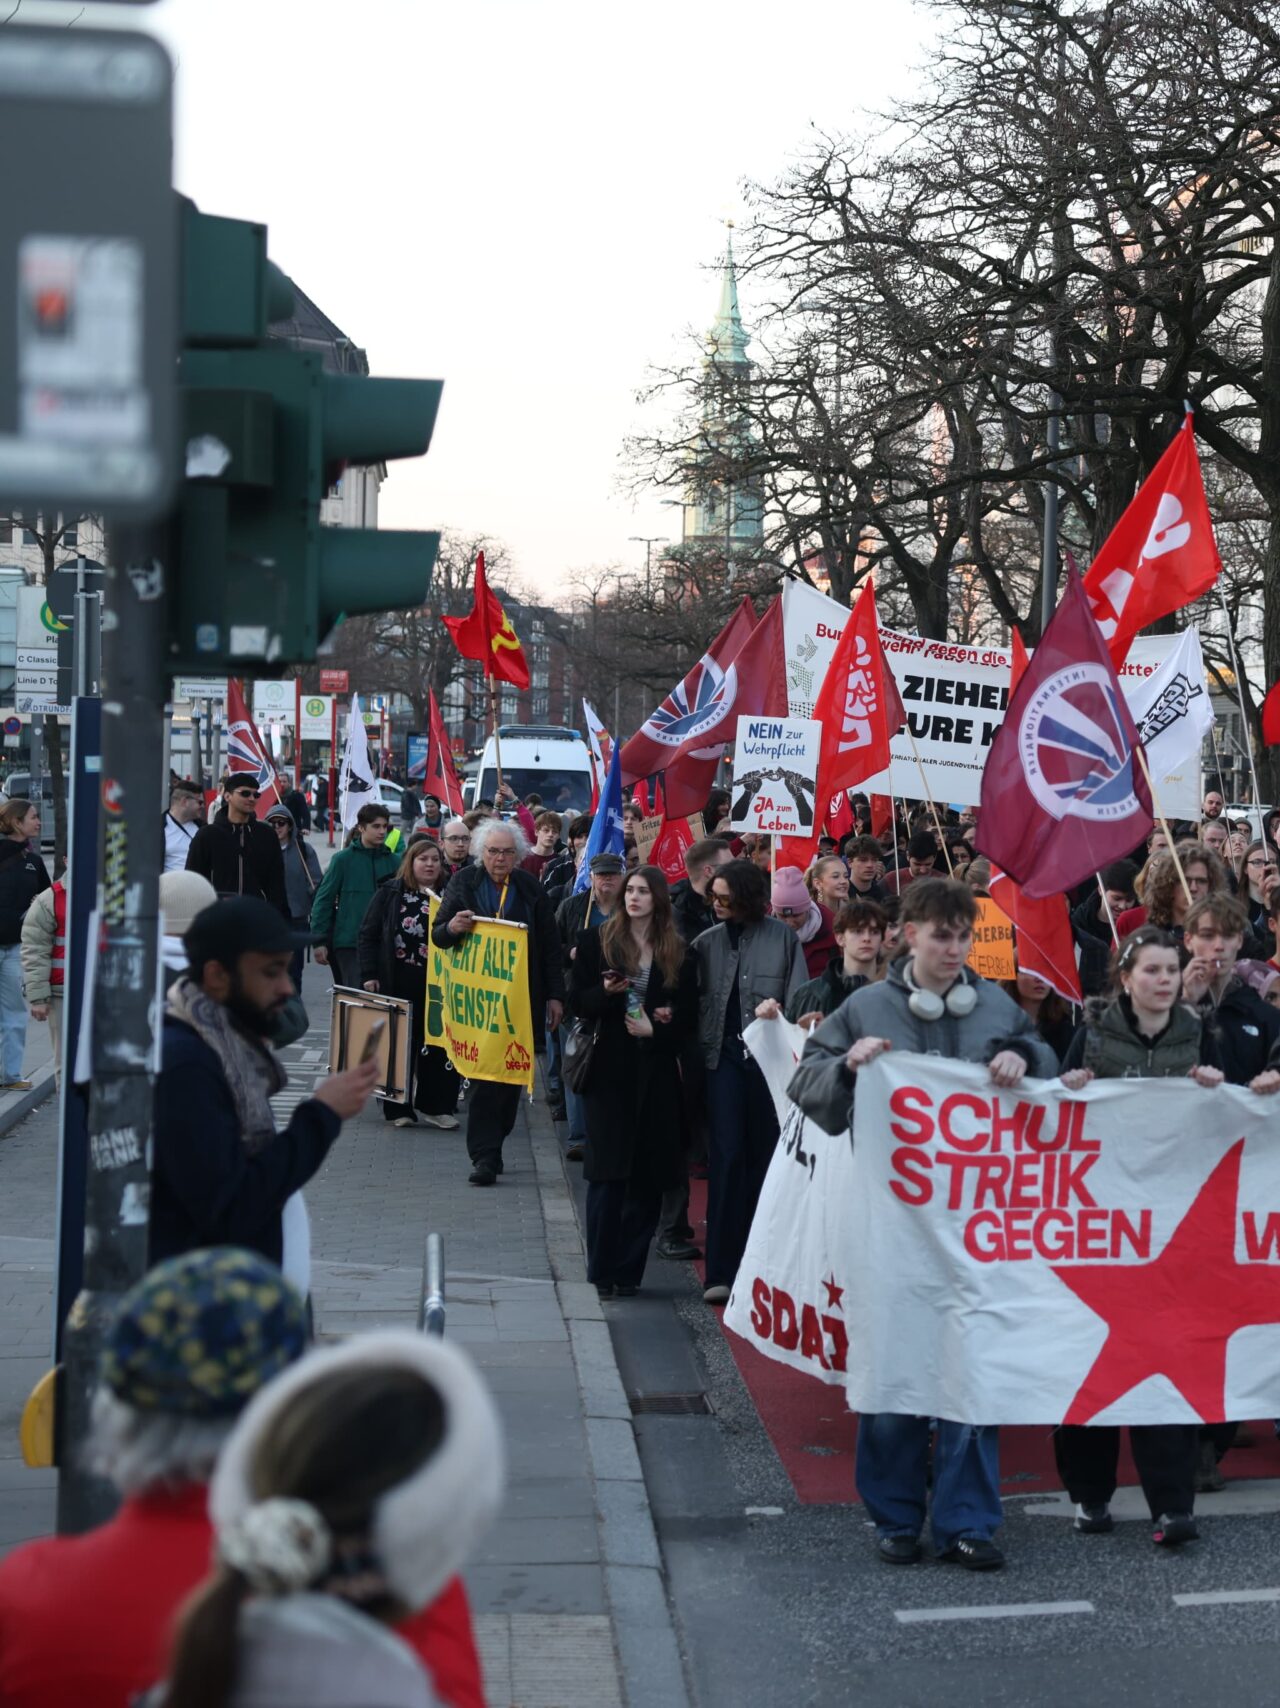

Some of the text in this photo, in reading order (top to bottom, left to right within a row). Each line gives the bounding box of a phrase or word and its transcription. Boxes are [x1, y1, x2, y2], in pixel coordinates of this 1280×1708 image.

[18, 655, 58, 664] C Classic
[982, 651, 1007, 665] die
[17, 677, 38, 685] Linie
[40, 677, 46, 685] D
[748, 722, 804, 740] NEIN zur
[743, 741, 806, 760] Wehrpflicht
[753, 796, 774, 813] JA
[757, 814, 797, 832] Leben
[481, 936, 517, 982] ALLE
[889, 1086, 1102, 1153] SCHUL
[888, 1147, 1101, 1211] STREIK
[963, 1208, 1153, 1262] GEGEN
